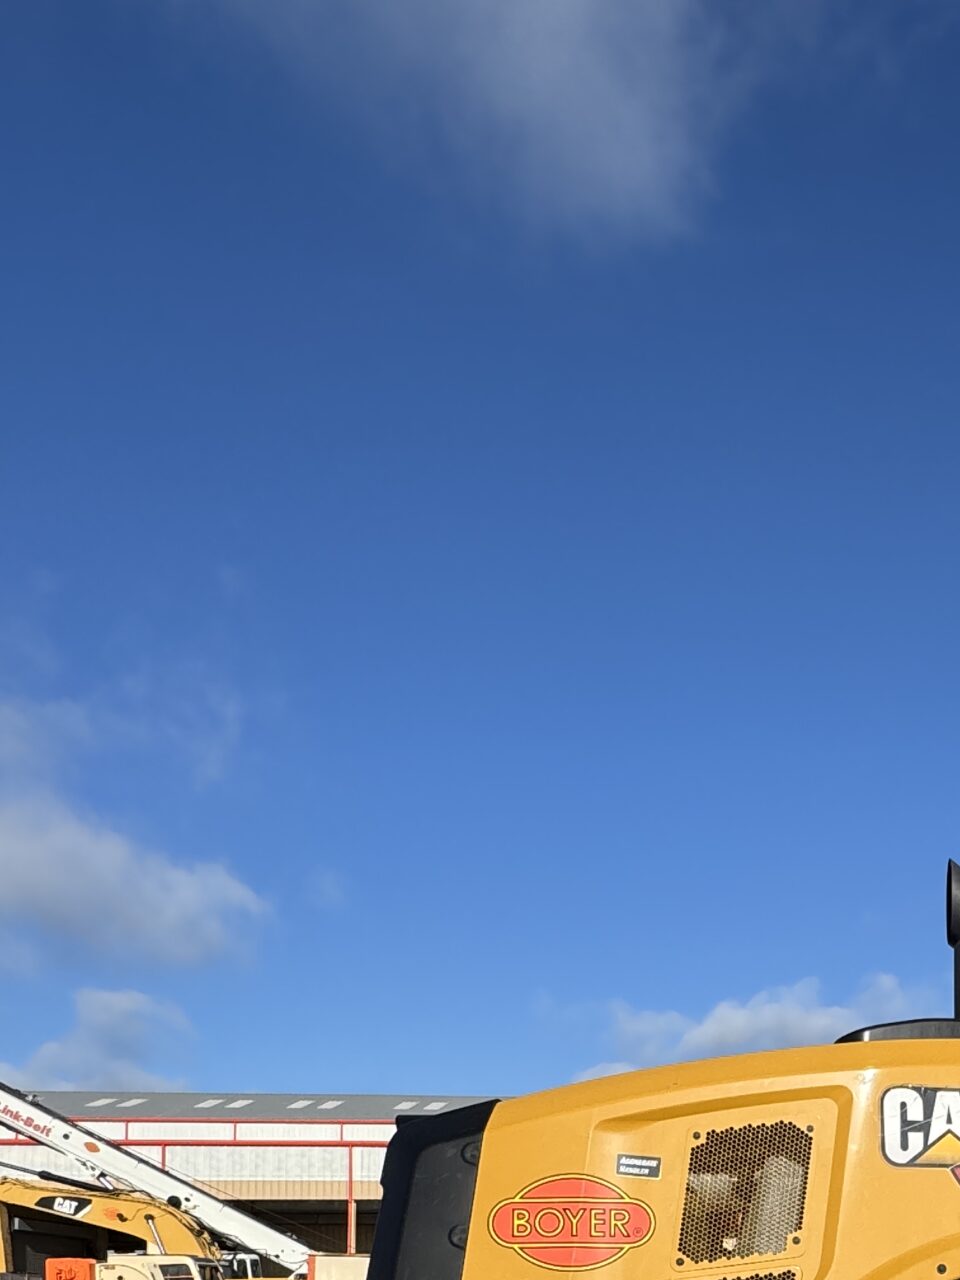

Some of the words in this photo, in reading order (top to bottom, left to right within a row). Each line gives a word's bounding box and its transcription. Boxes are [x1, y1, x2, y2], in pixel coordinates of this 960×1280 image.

[0, 1102, 52, 1138] ink-Belt
[53, 1197, 79, 1215] CAT
[511, 1207, 631, 1238] BOYER
